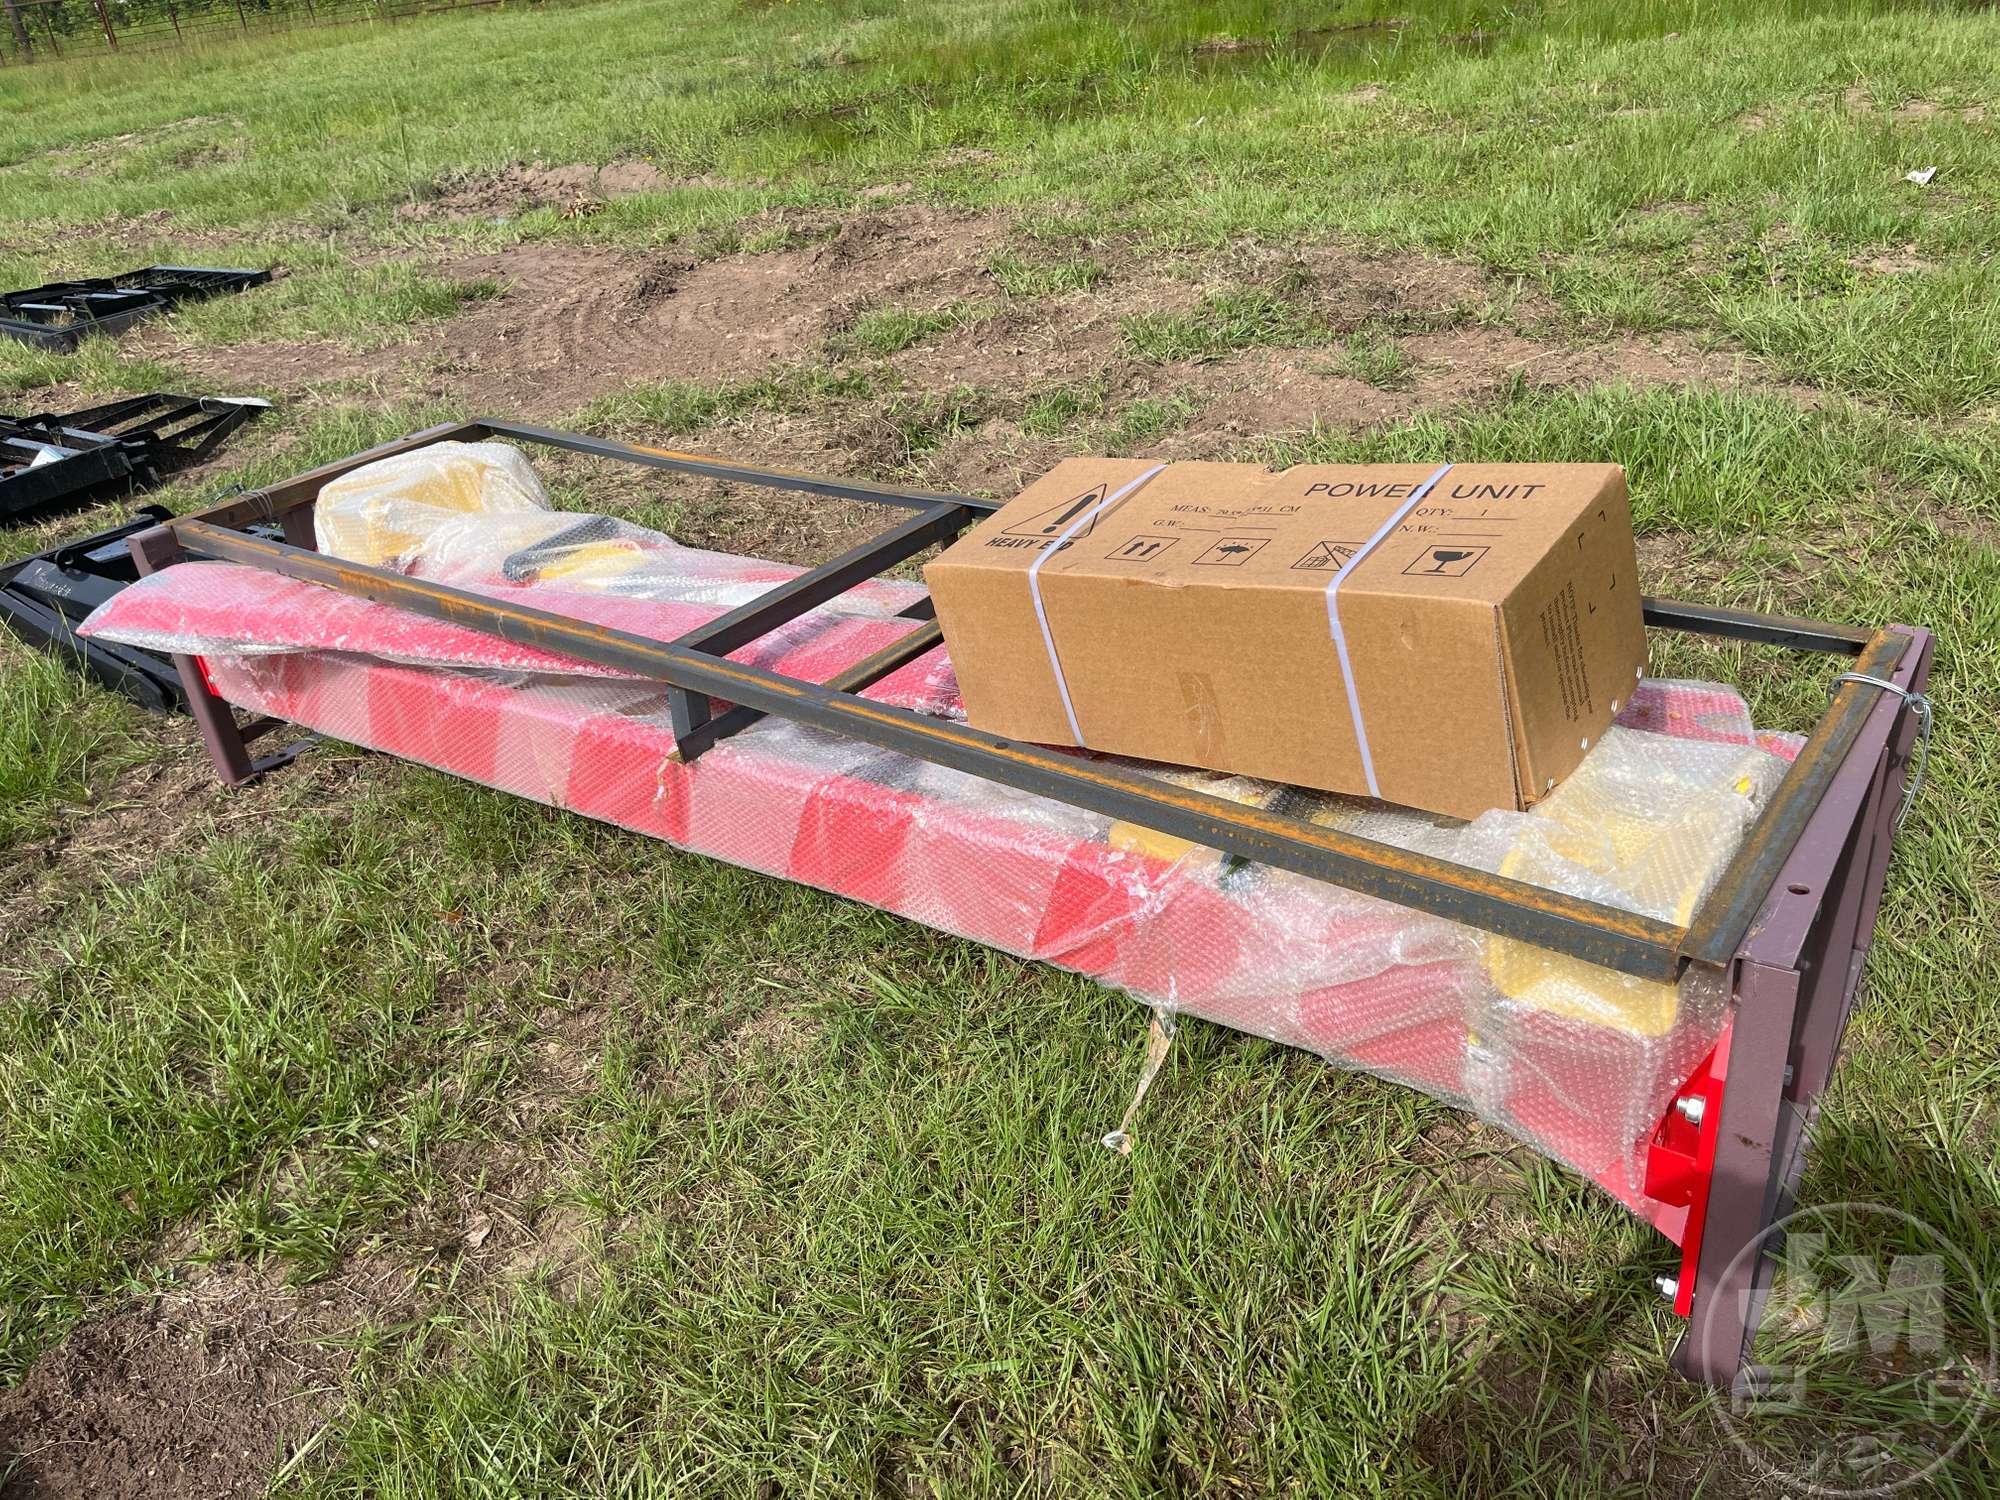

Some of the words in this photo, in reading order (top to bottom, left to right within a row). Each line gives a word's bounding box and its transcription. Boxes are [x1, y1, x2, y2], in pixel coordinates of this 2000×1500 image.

[1451, 484, 1546, 500] UNIT
[1280, 504, 1303, 513] CM
[1415, 507, 1454, 517] QTY:
[984, 537, 1040, 549] HEAVY
